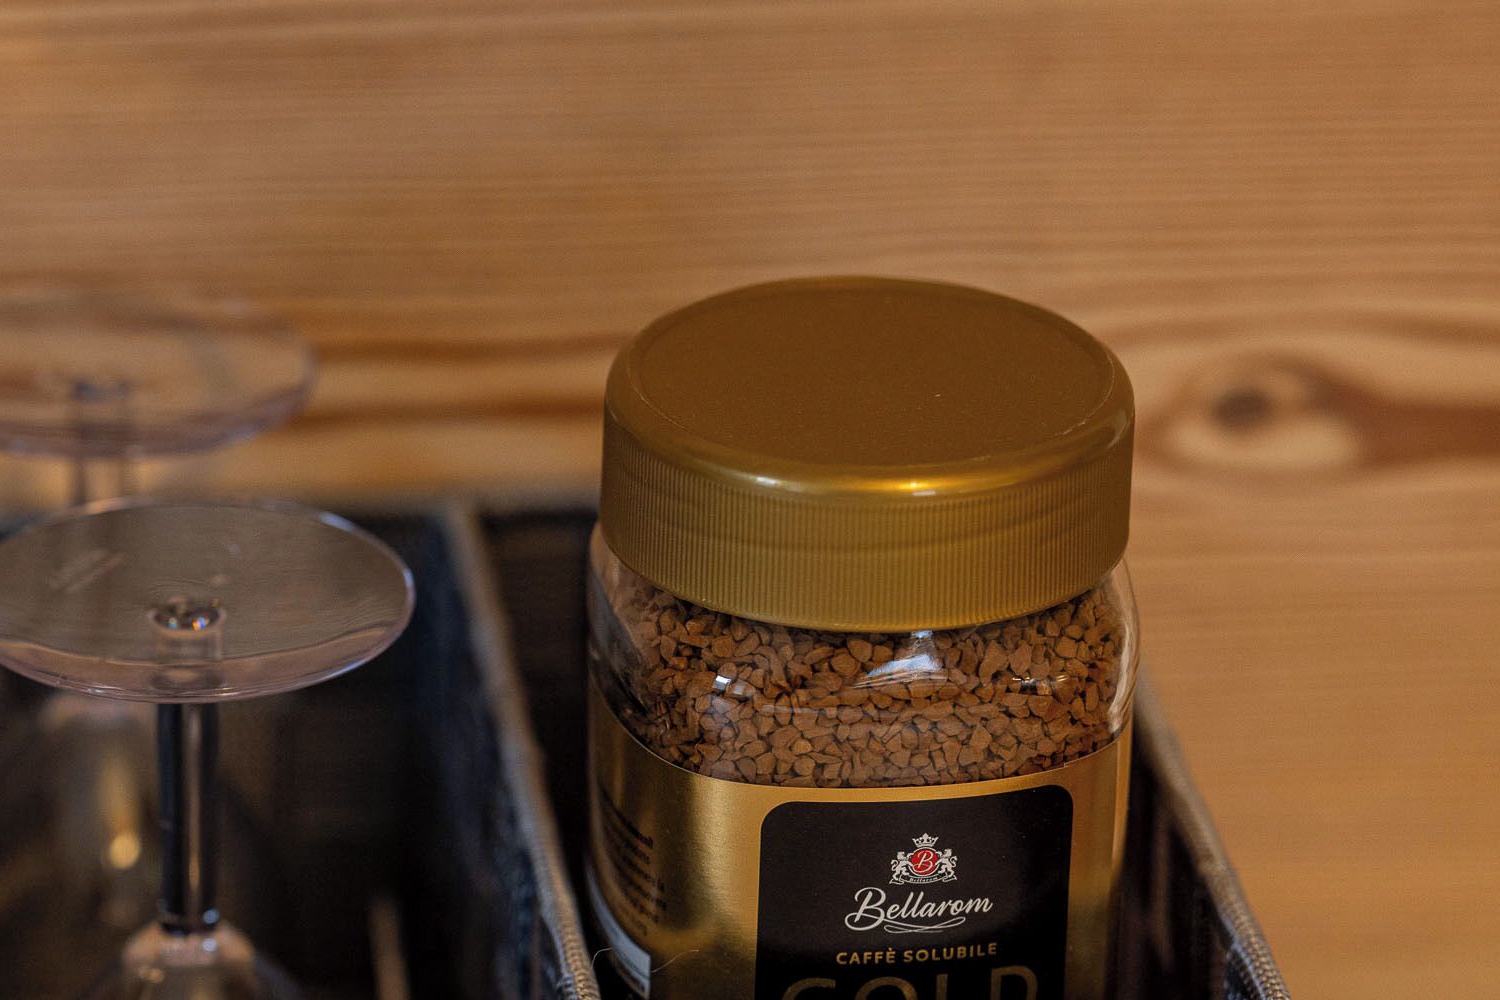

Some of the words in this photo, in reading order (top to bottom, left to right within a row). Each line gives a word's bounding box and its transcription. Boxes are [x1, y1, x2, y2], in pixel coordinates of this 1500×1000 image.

[912, 849, 934, 873] B
[845, 887, 993, 933] Bellarom
[836, 948, 896, 965] CAFFÈ
[903, 943, 997, 962] SOLUBILE
